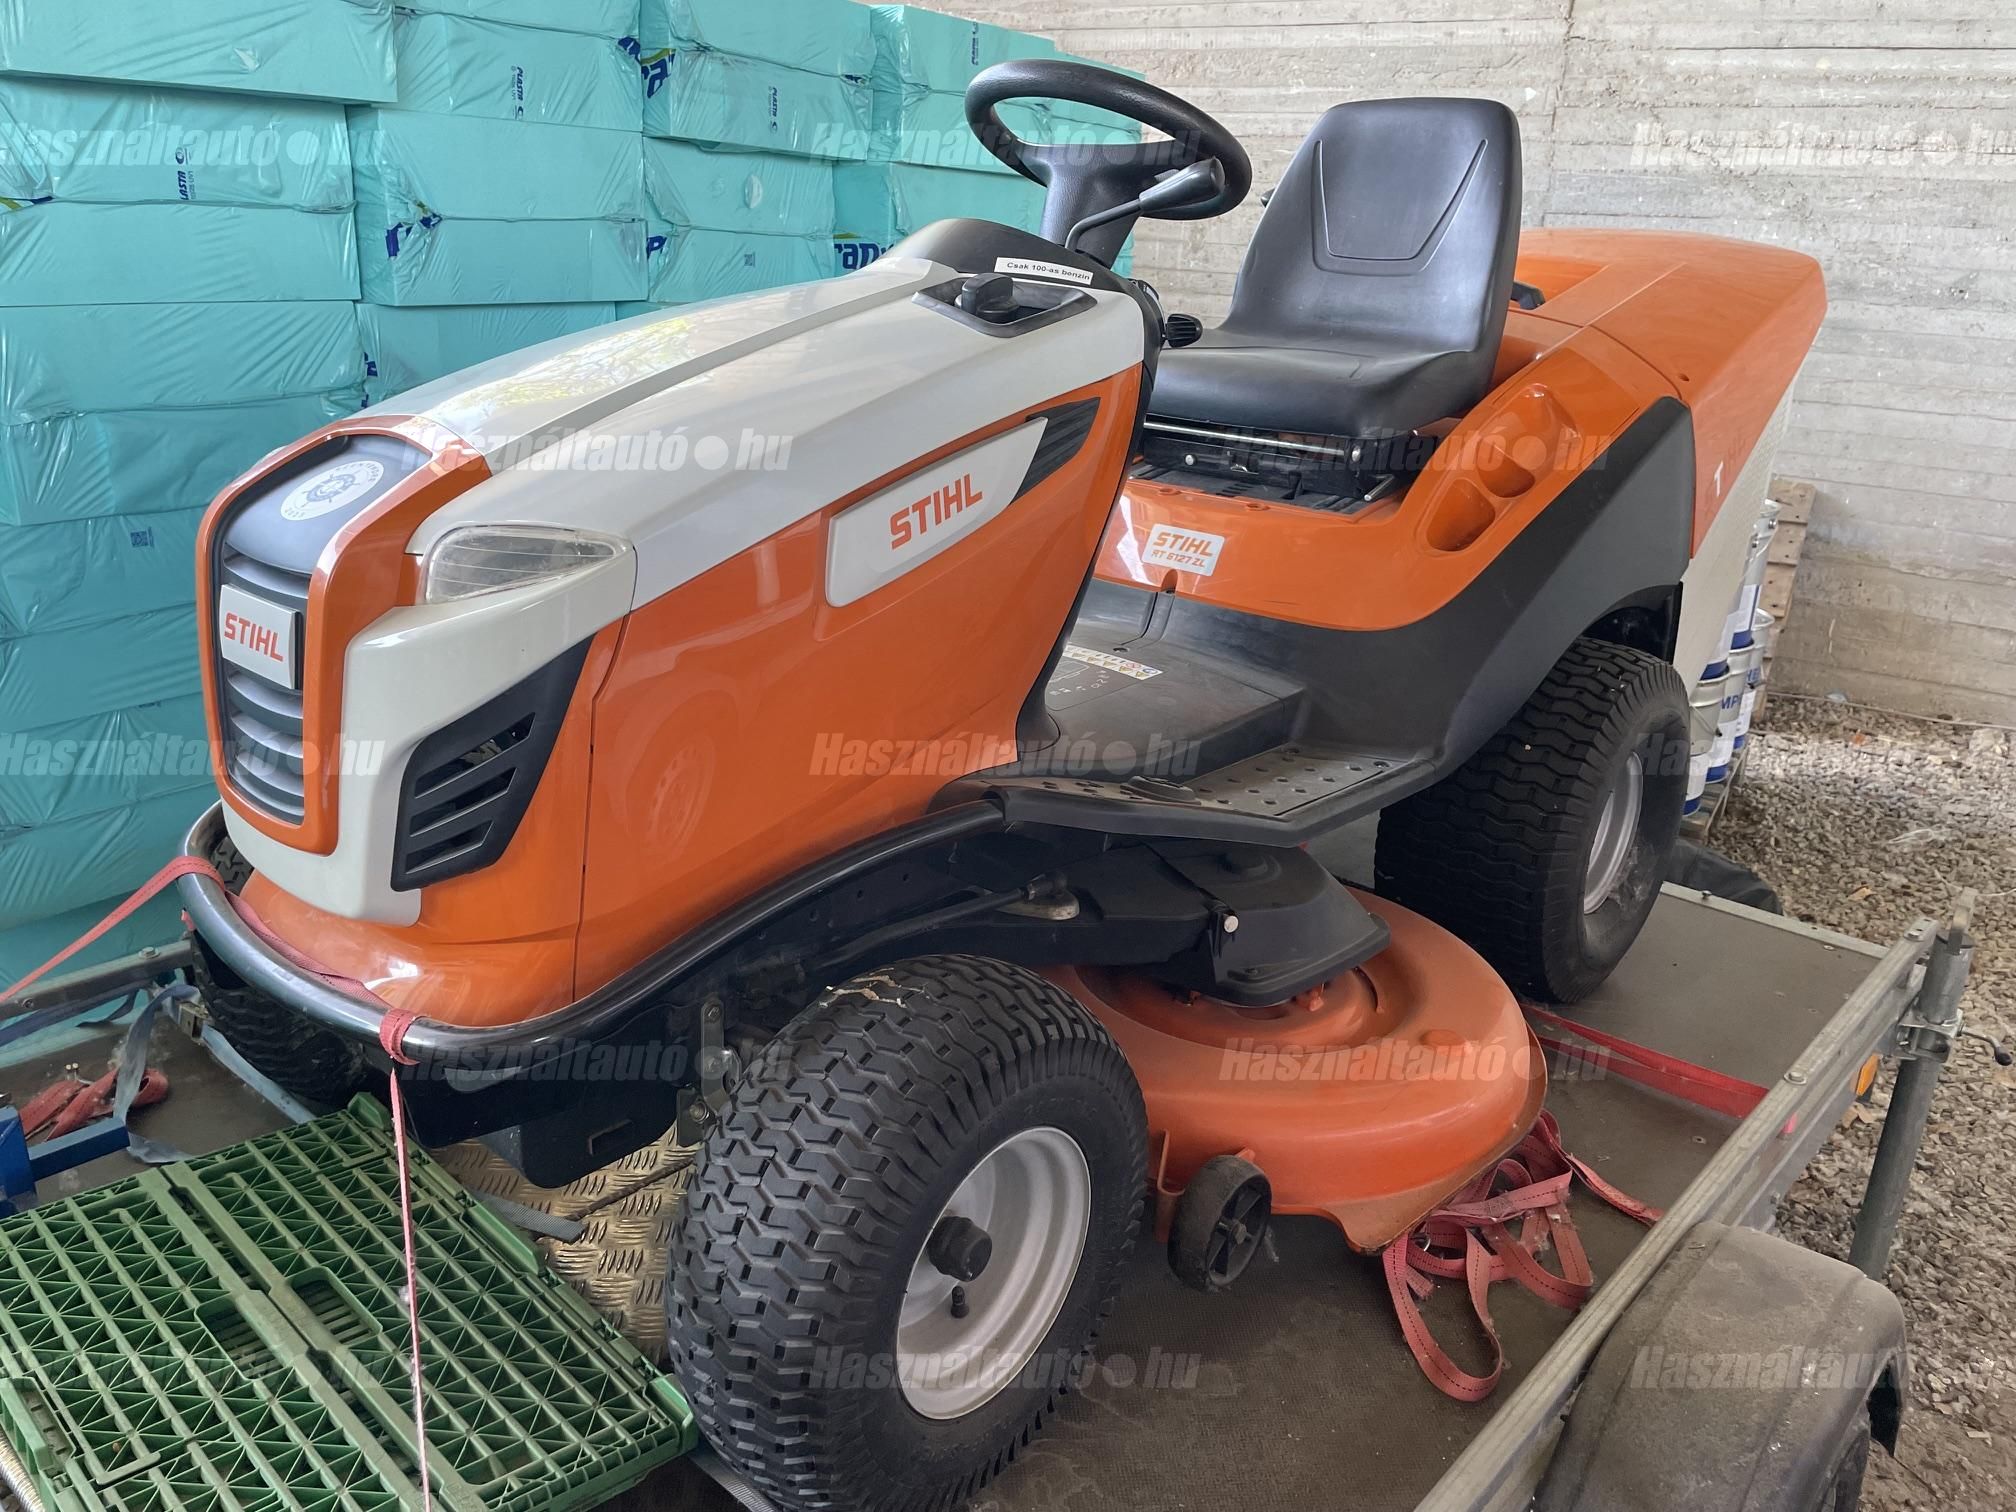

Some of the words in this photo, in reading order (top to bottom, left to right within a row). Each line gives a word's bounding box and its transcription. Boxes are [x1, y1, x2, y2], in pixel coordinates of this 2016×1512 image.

[516, 66, 524, 101] PLASTA
[1006, 262, 1029, 270] Csak
[1032, 265, 1060, 274] 100-as
[1061, 269, 1090, 280] benzin
[889, 473, 983, 550] STIHL
[1151, 549, 1167, 559] RT
[1166, 551, 1192, 564] 6127
[1192, 556, 1205, 567] ZL
[1153, 531, 1213, 557] STIHL
[224, 612, 284, 662] STIHL
